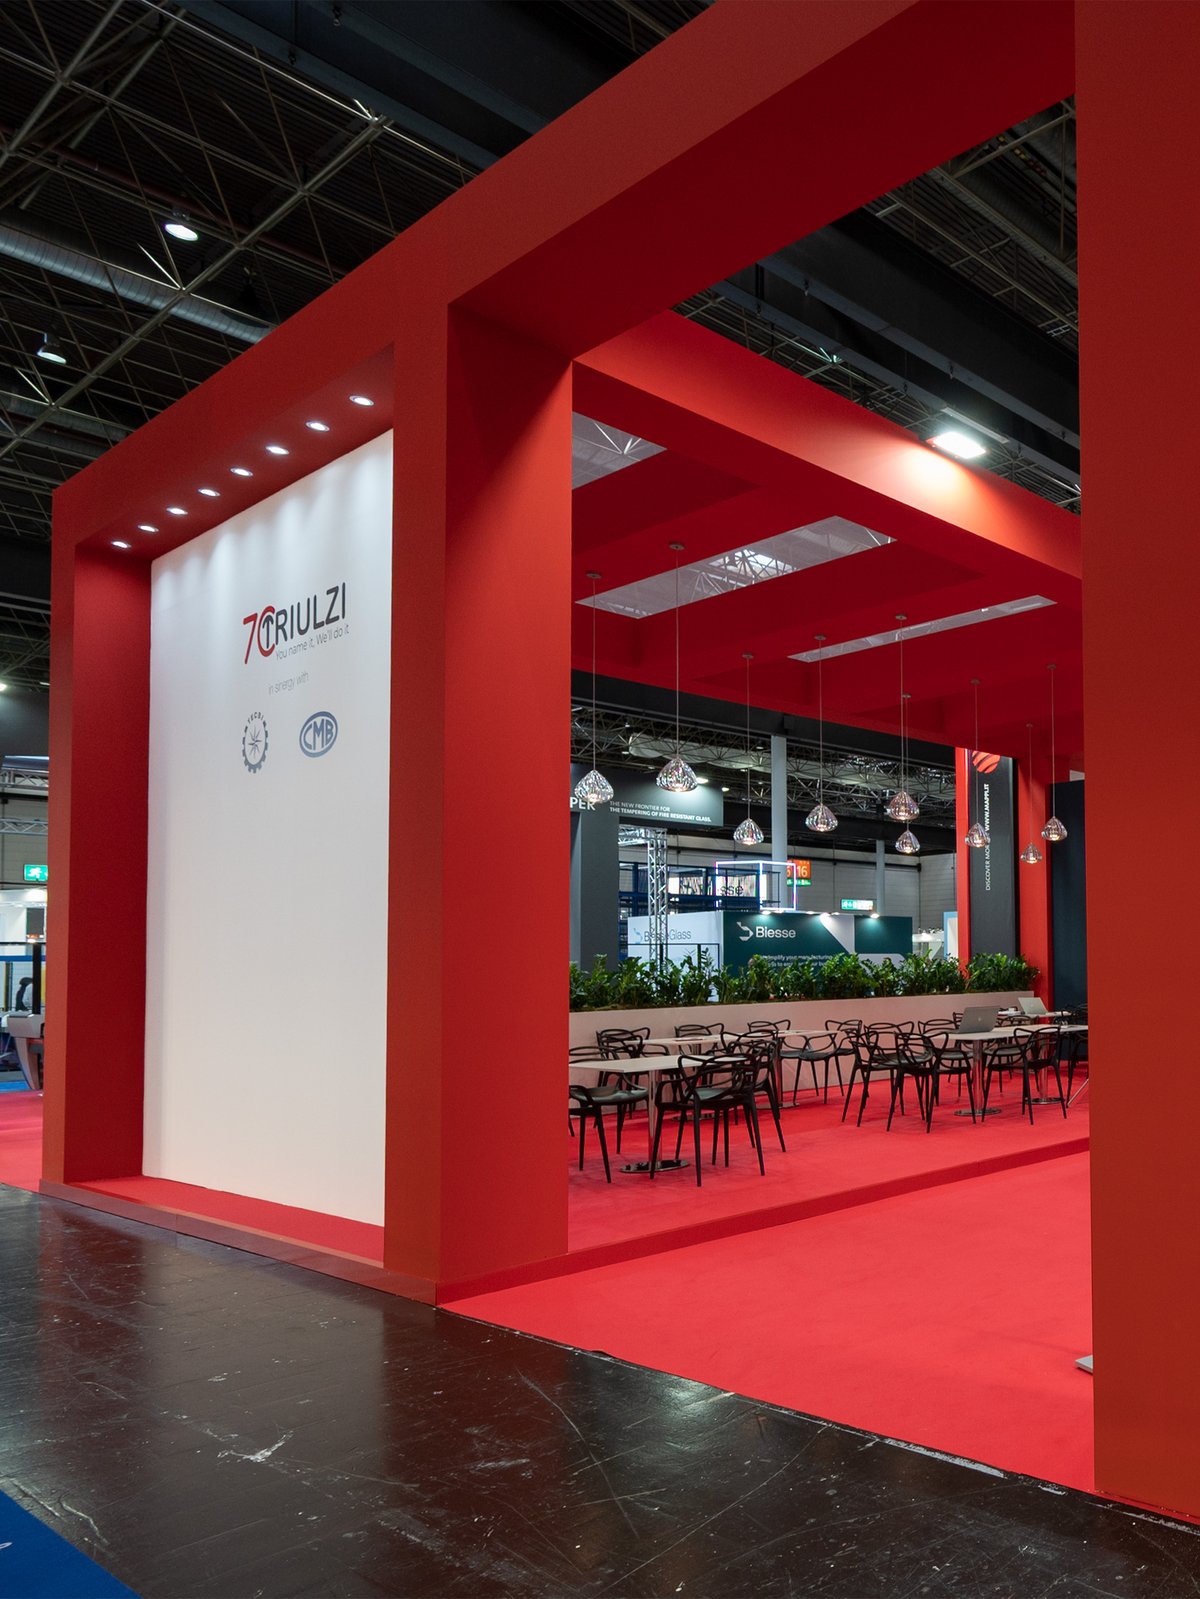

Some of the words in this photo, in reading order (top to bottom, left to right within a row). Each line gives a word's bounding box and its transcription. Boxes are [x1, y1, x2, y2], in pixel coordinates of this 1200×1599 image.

[303, 718, 334, 751] CMB
[621, 808, 651, 816] TEMPERING
[635, 803, 659, 811] FRONTIER
[796, 865, 808, 878] 16
[755, 926, 796, 938] Biesse
